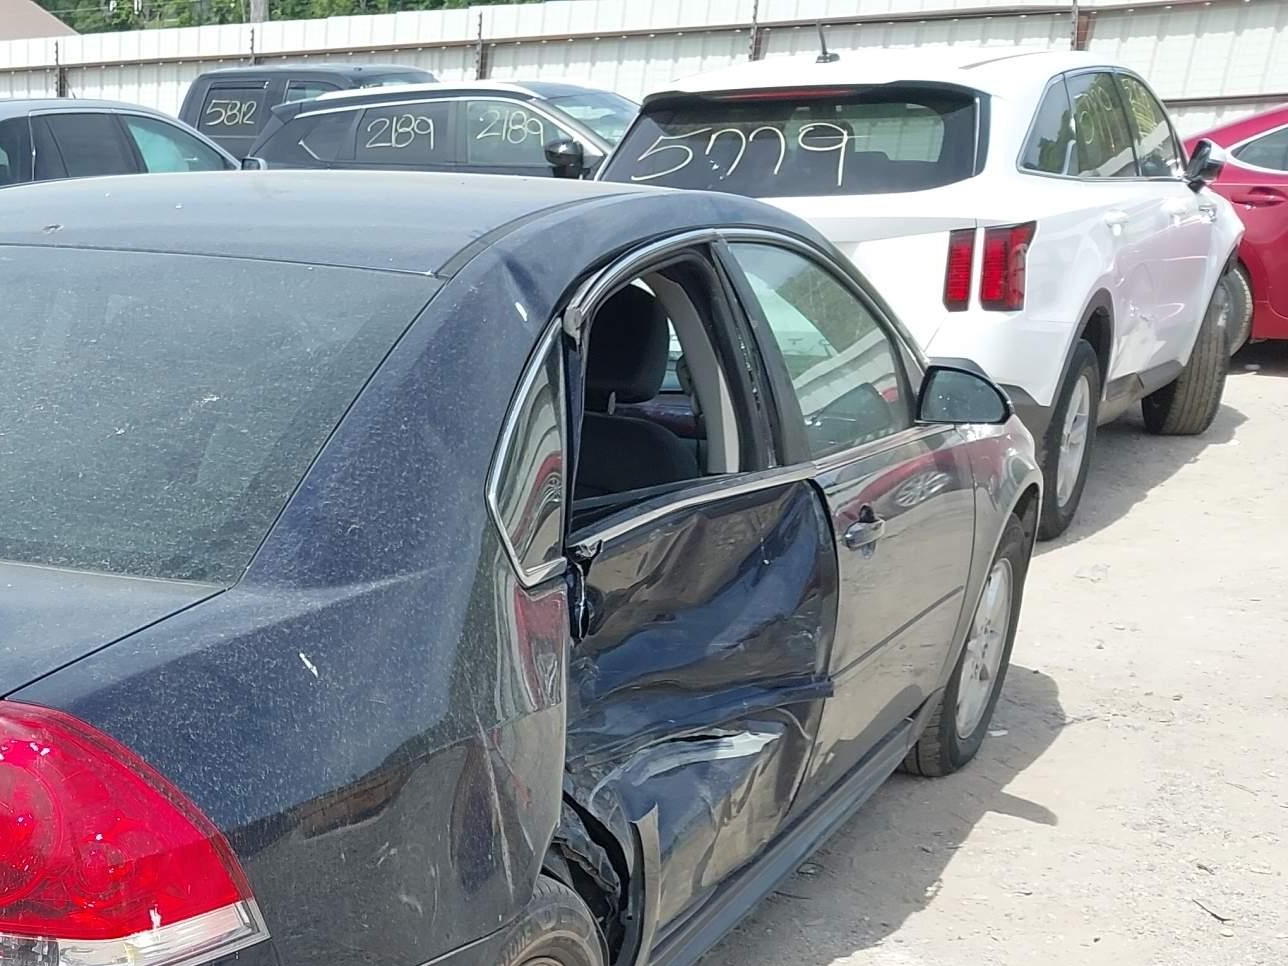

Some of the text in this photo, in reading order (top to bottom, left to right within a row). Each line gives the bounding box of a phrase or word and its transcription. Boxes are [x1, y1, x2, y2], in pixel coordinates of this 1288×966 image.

[205, 99, 258, 127] 5812
[365, 113, 435, 150] 2189
[475, 109, 545, 146] 2189
[630, 122, 848, 187] 5779
